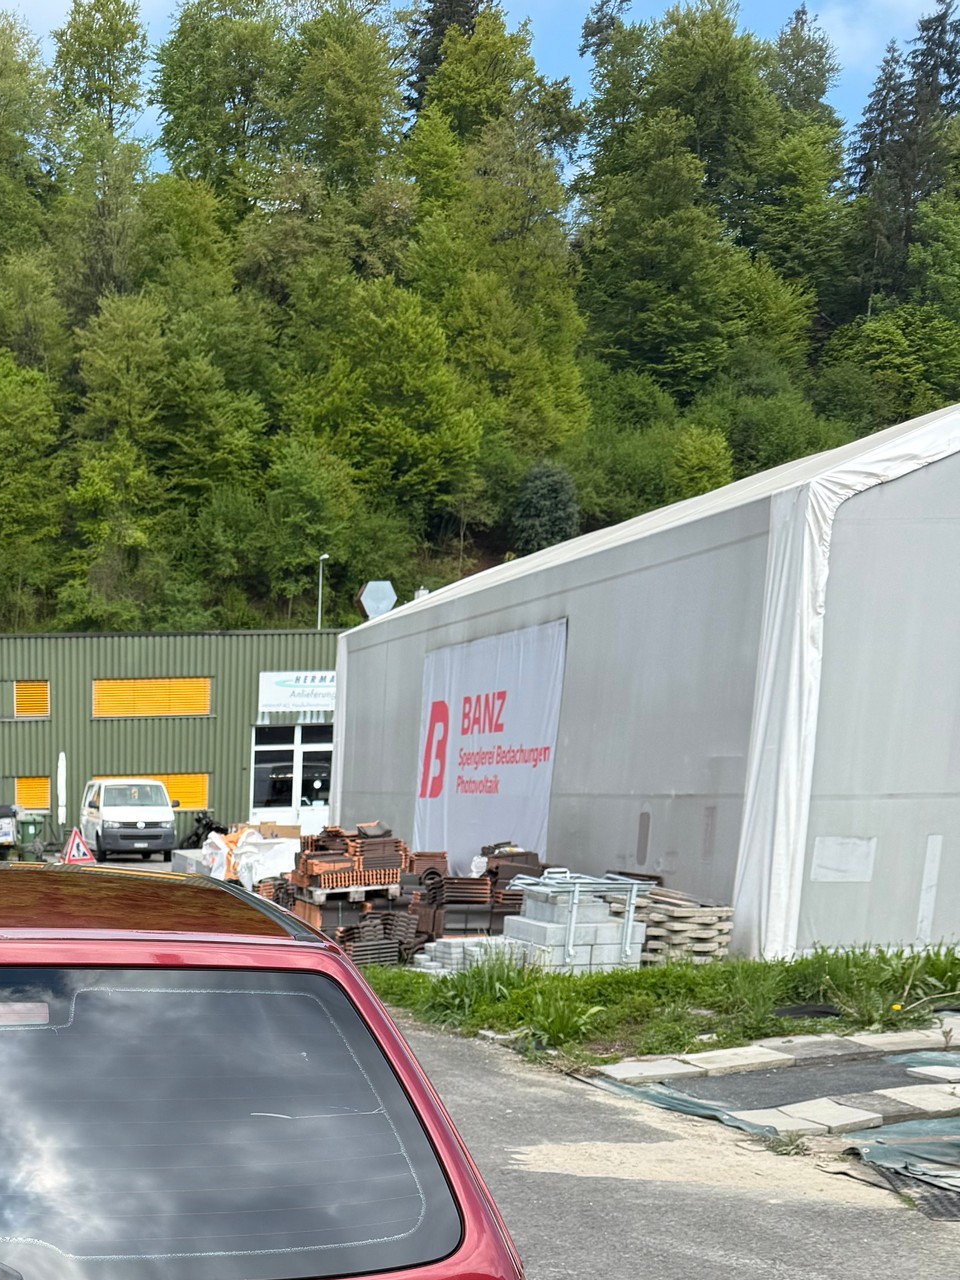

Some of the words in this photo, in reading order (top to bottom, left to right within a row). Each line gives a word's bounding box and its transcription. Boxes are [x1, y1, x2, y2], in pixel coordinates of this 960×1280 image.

[294, 675, 336, 684] HERMA
[461, 690, 507, 736] BANZ
[458, 746, 496, 770] Spenglerei
[496, 744, 550, 768] Bedachungen
